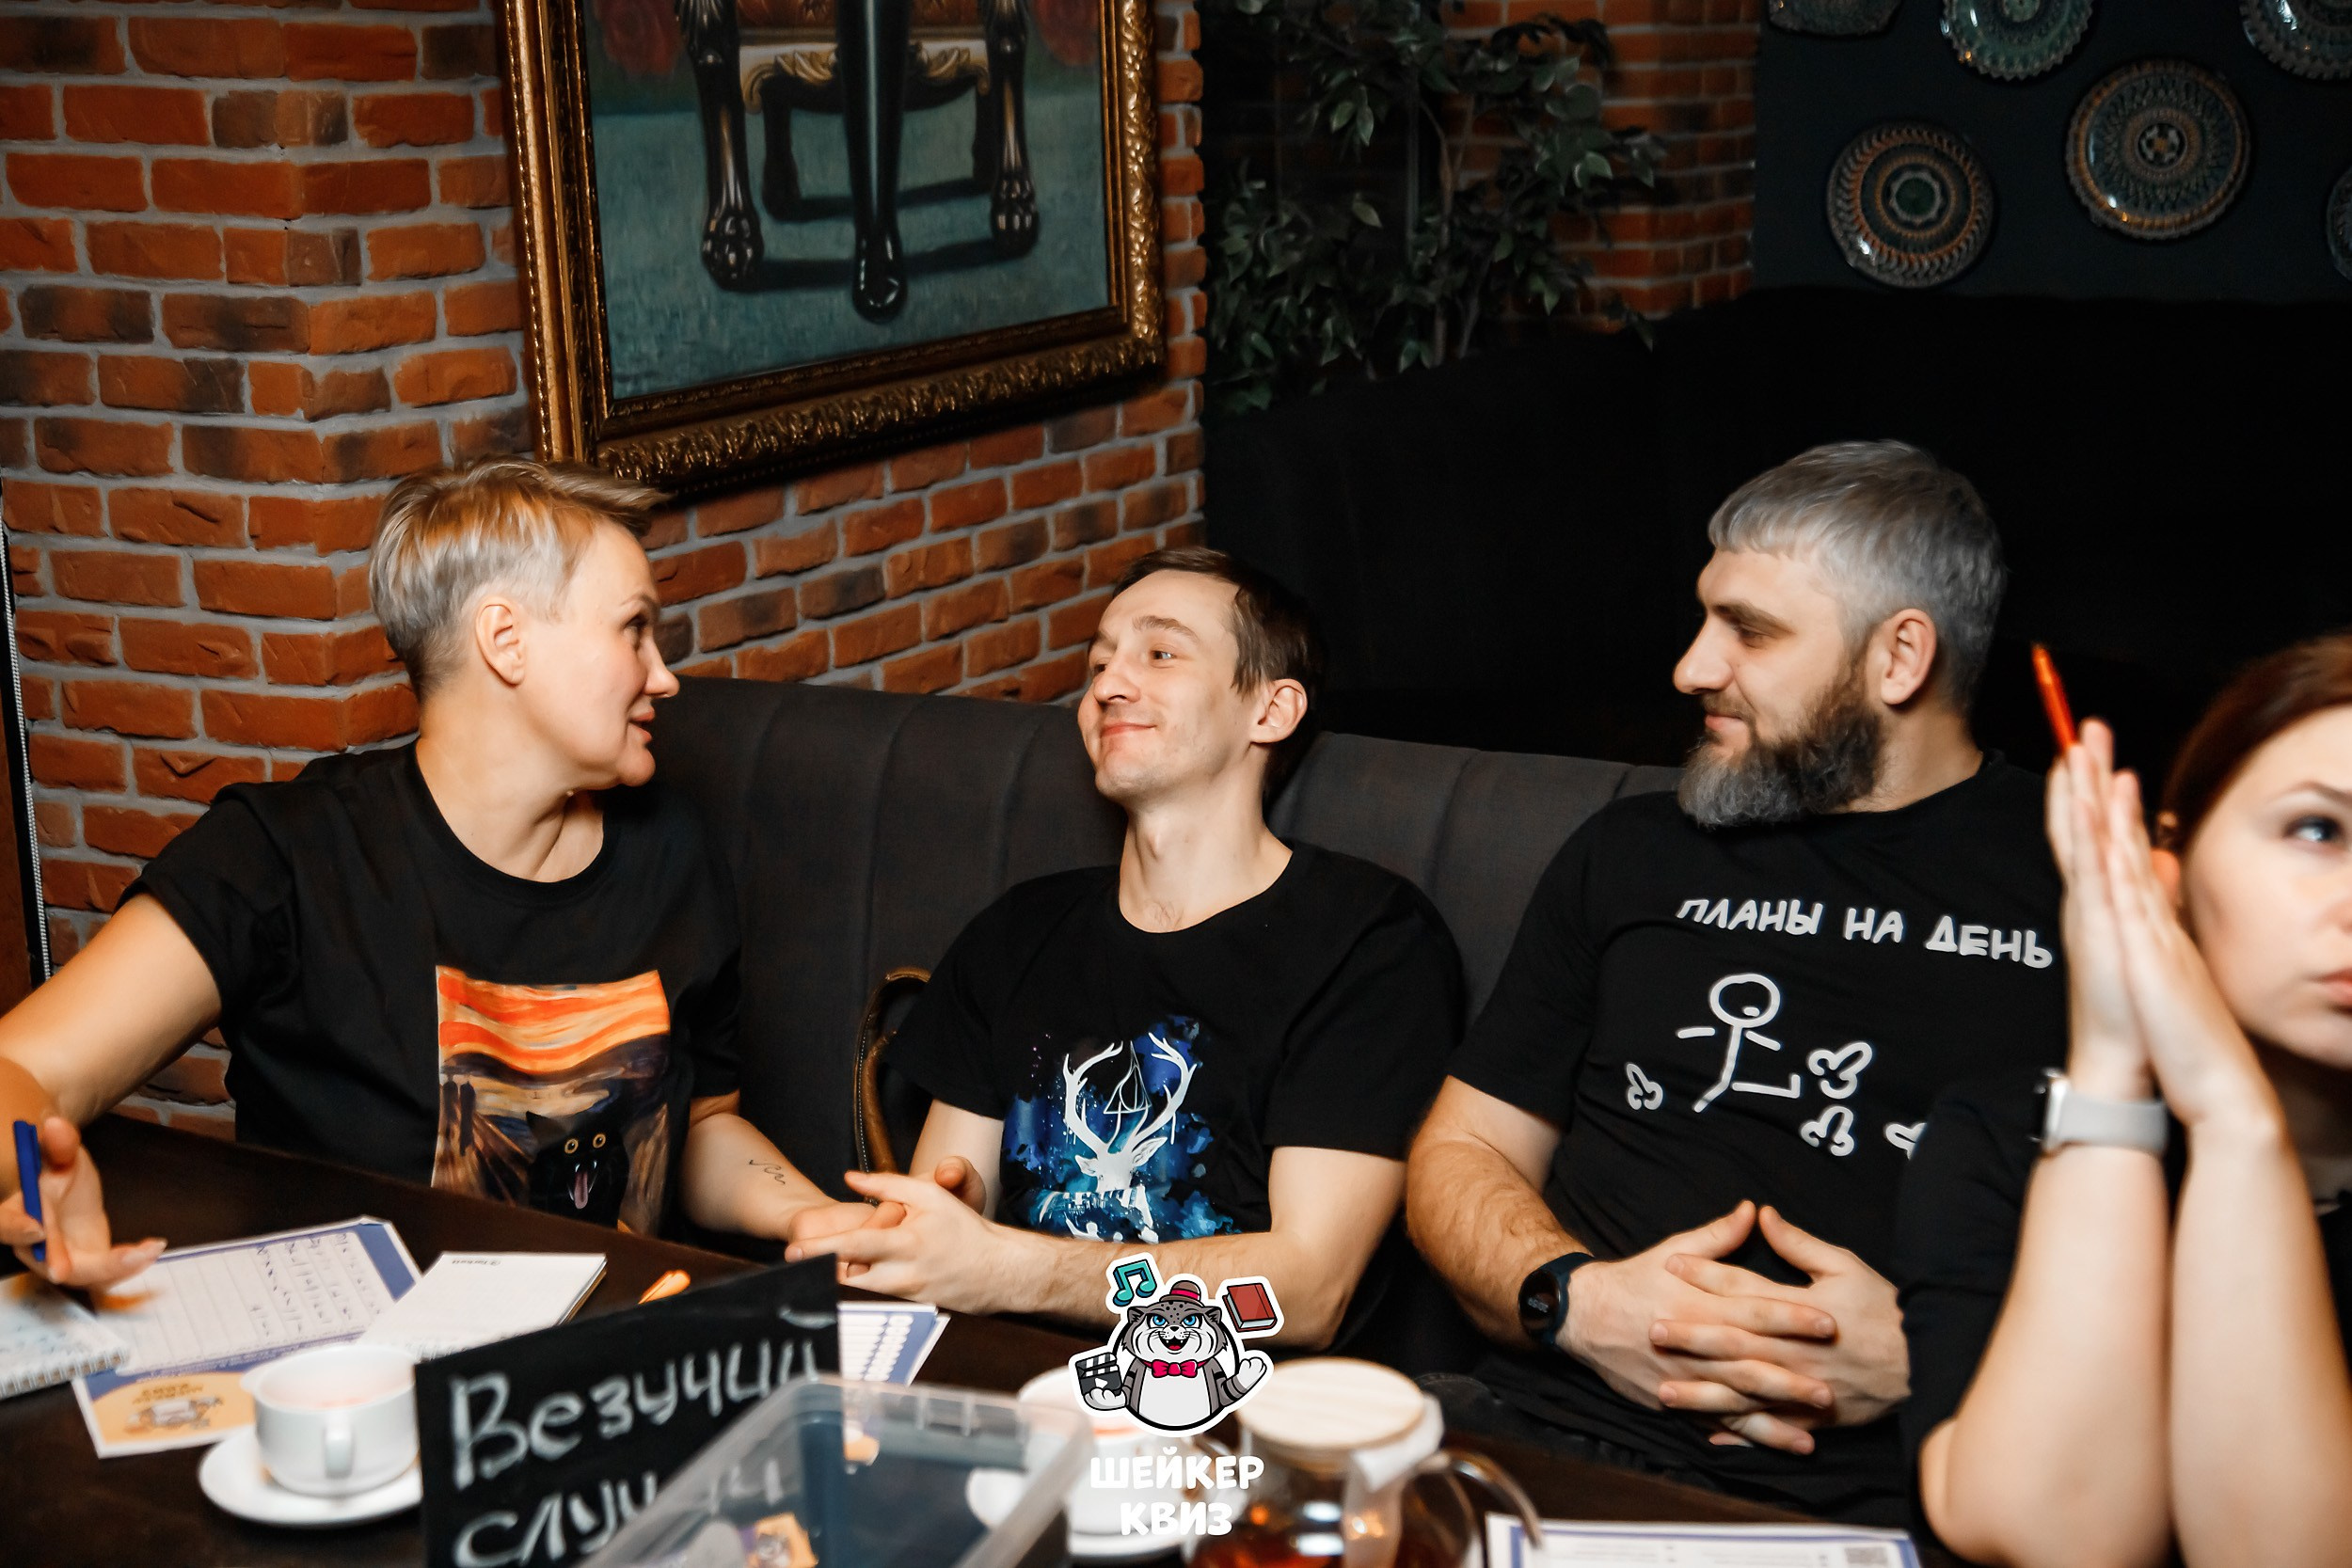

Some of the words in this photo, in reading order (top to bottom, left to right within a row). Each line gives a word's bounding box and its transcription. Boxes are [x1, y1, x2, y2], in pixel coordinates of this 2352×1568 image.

[1677, 898, 1823, 935] ПЛАНЫ
[1844, 907, 1903, 943] НА
[1925, 915, 2052, 968] ДЕНЬ
